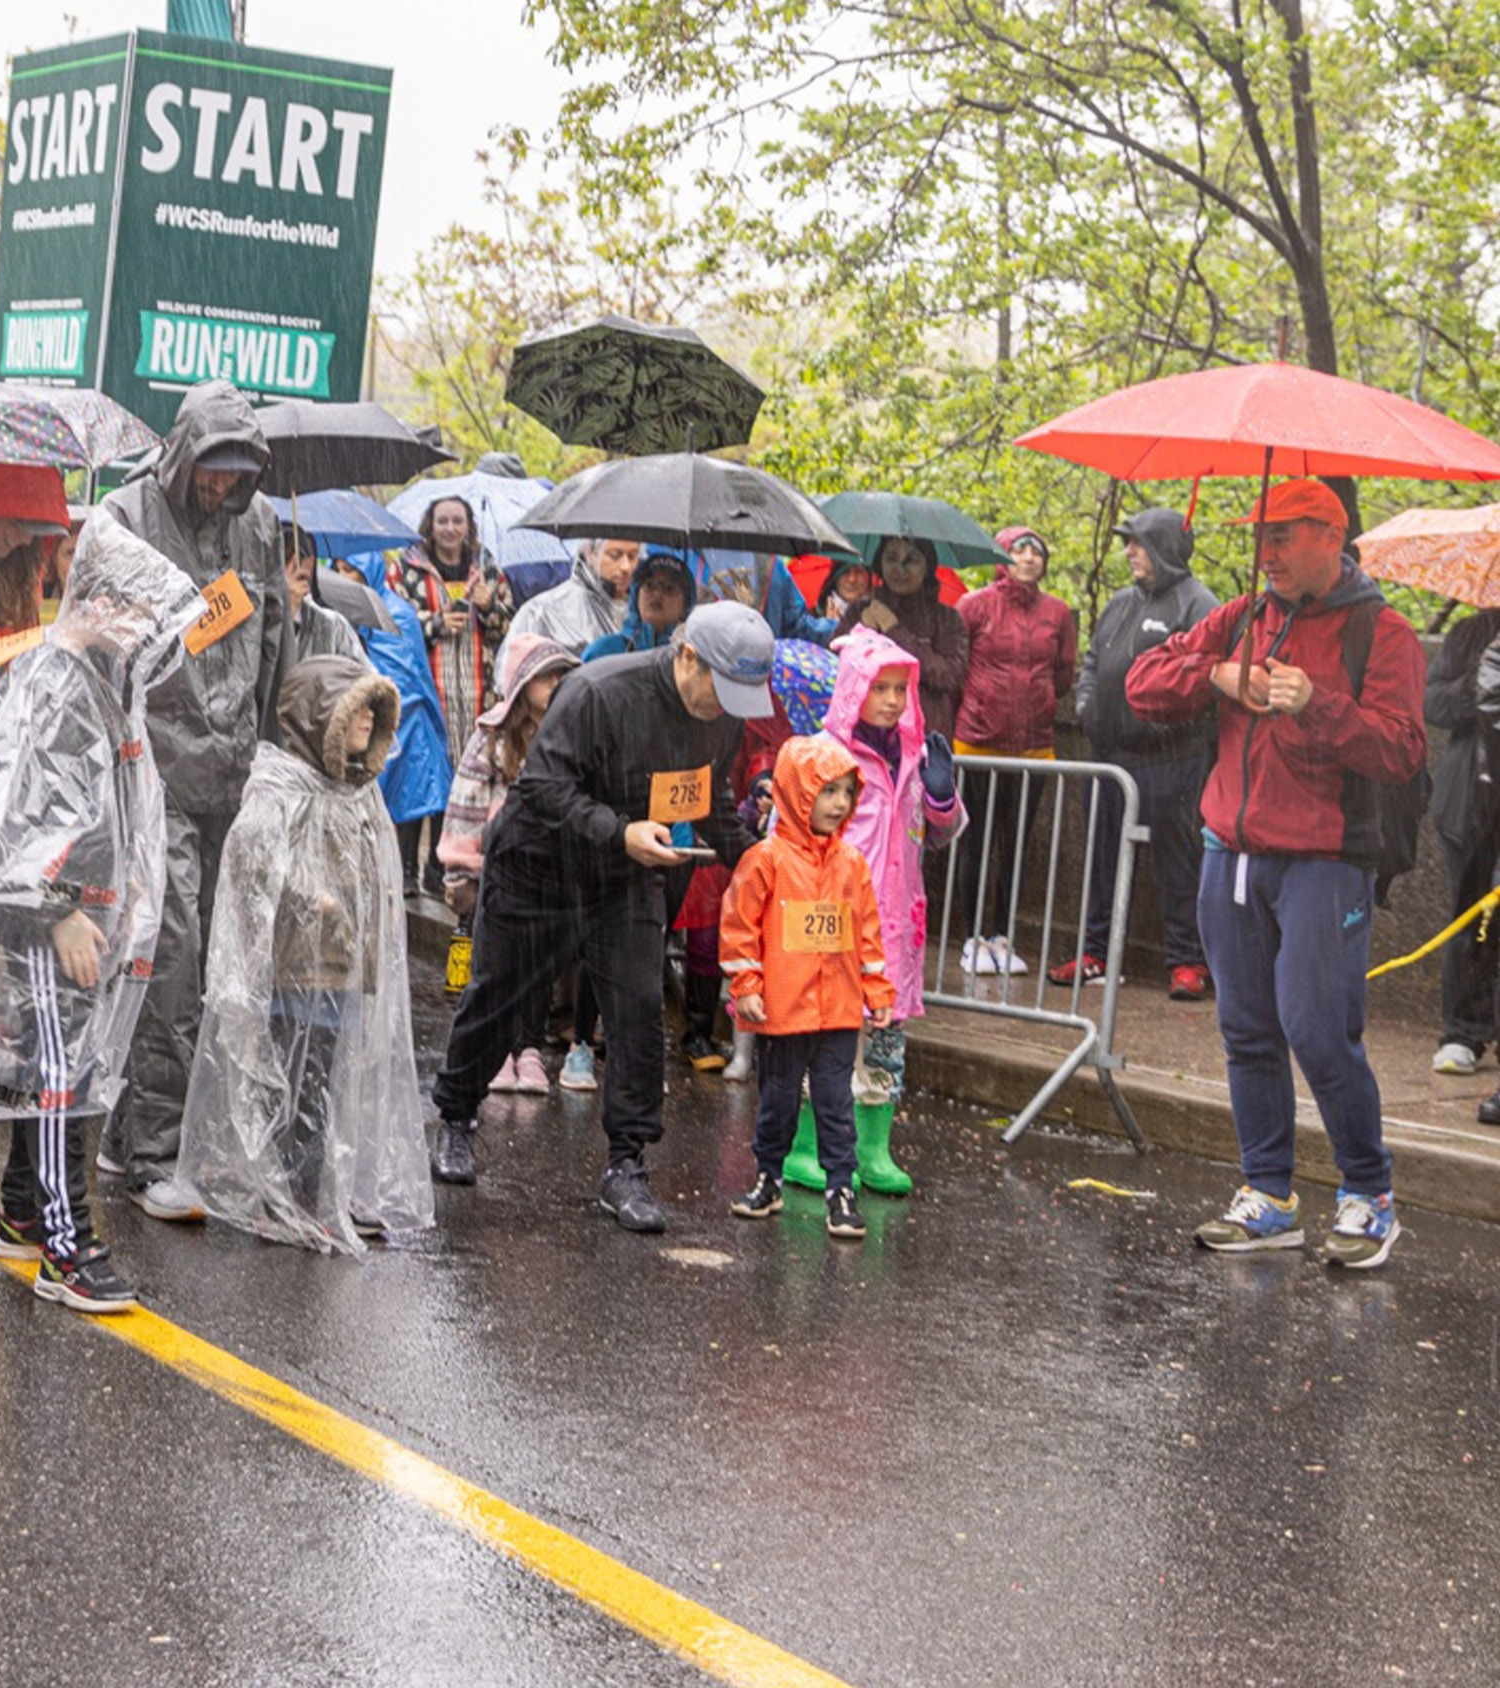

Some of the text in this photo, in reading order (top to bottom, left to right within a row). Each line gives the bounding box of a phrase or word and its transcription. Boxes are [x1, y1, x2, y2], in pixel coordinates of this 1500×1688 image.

[8, 83, 117, 186] START
[141, 82, 374, 200] START
[155, 203, 340, 249] #WCSRunfortheWild
[156, 299, 322, 331] WILDLIFE CONSERVATION SOCIETY
[150, 317, 223, 379] RUN
[236, 327, 319, 390] WILD
[804, 913, 844, 935] 2781
